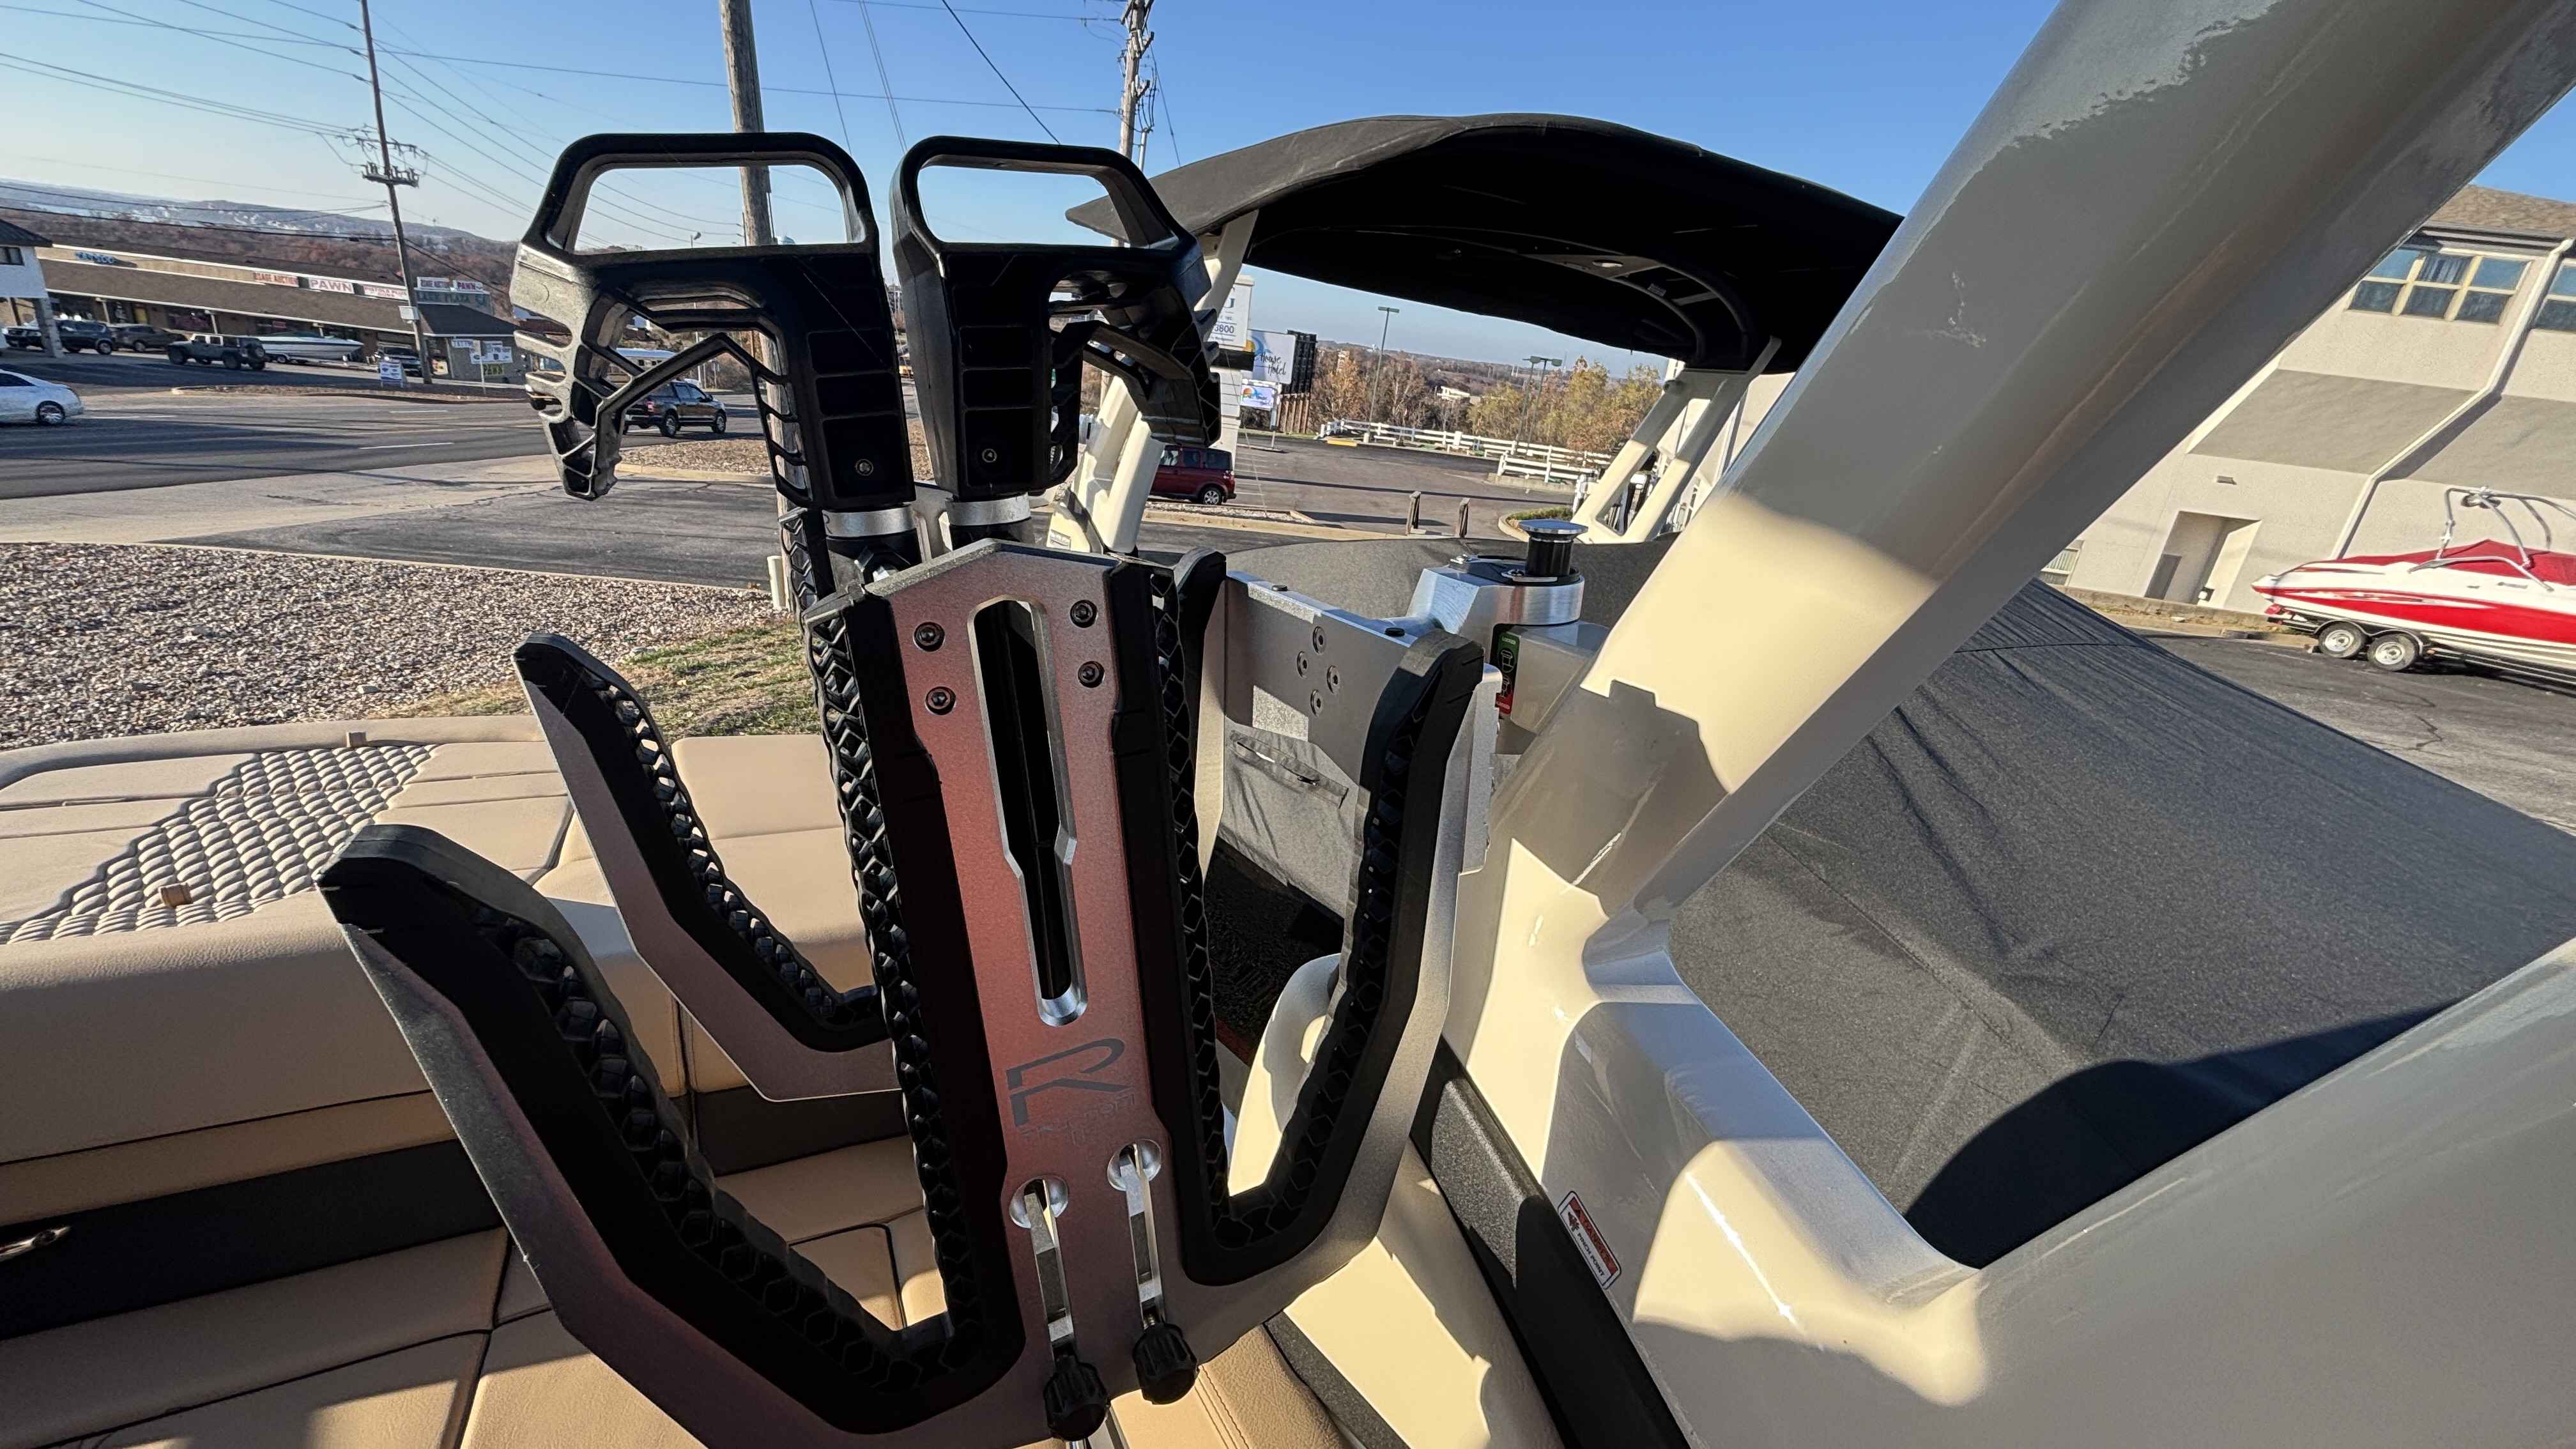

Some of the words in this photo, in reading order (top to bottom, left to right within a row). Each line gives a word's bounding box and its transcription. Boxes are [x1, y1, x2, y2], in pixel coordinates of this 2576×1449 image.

[310, 279, 352, 292] PAWN
[457, 282, 476, 290] PAWN
[1214, 324, 1234, 334] 3800
[1260, 353, 1282, 364] House
[1268, 362, 1286, 377] Hotel
[1577, 1232, 1592, 1256] PINCH
[1590, 1254, 1606, 1276] POINT
